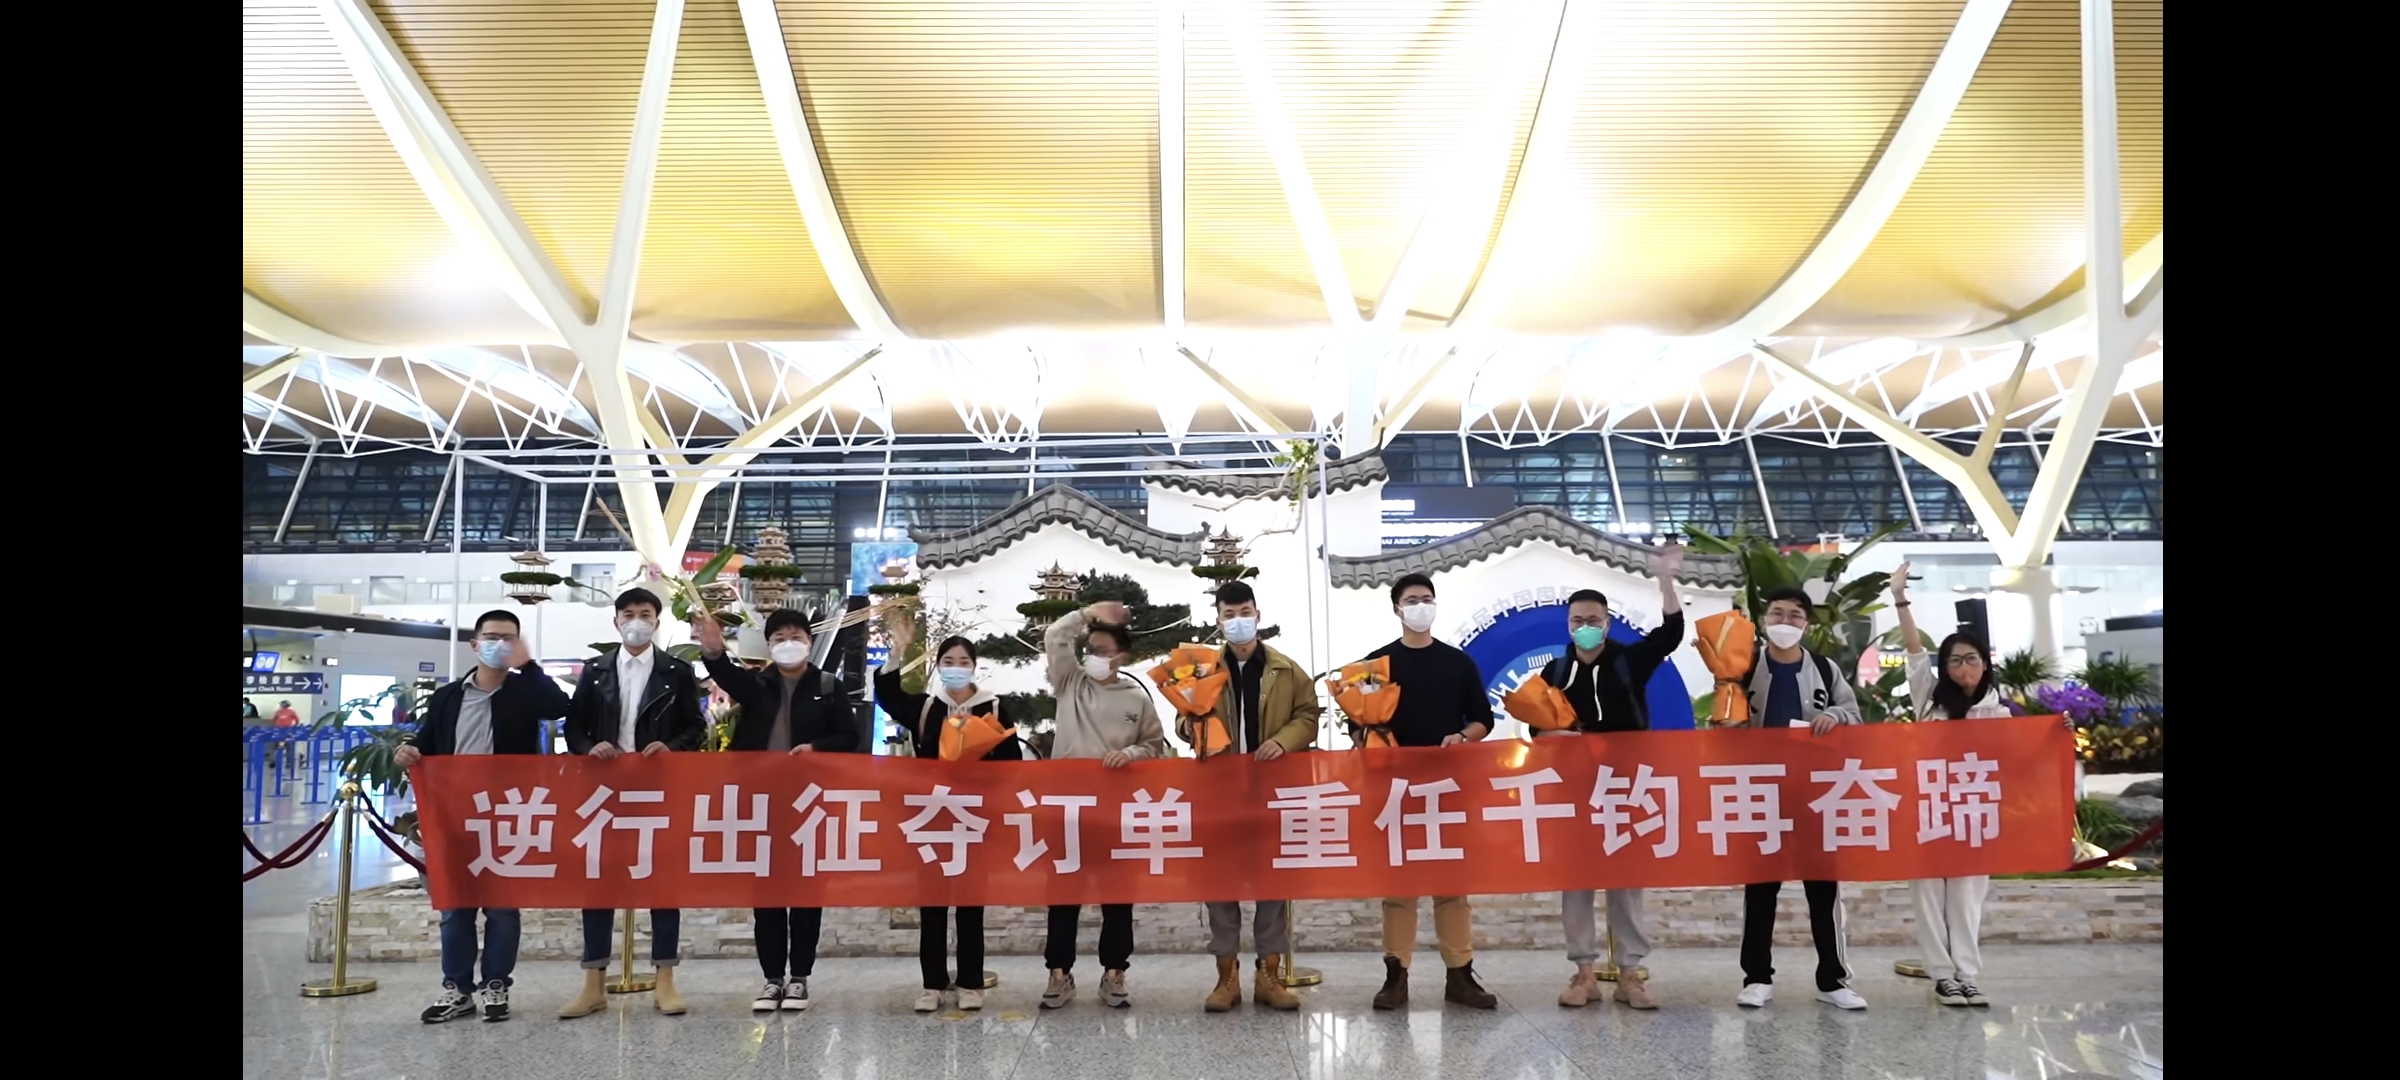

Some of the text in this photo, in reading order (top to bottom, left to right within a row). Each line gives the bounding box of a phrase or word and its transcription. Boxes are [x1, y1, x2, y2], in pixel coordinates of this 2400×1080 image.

[1813, 688, 1827, 712] S
[464, 752, 2002, 879] 逆行出征夺订单 重任千钧再奋蹄
